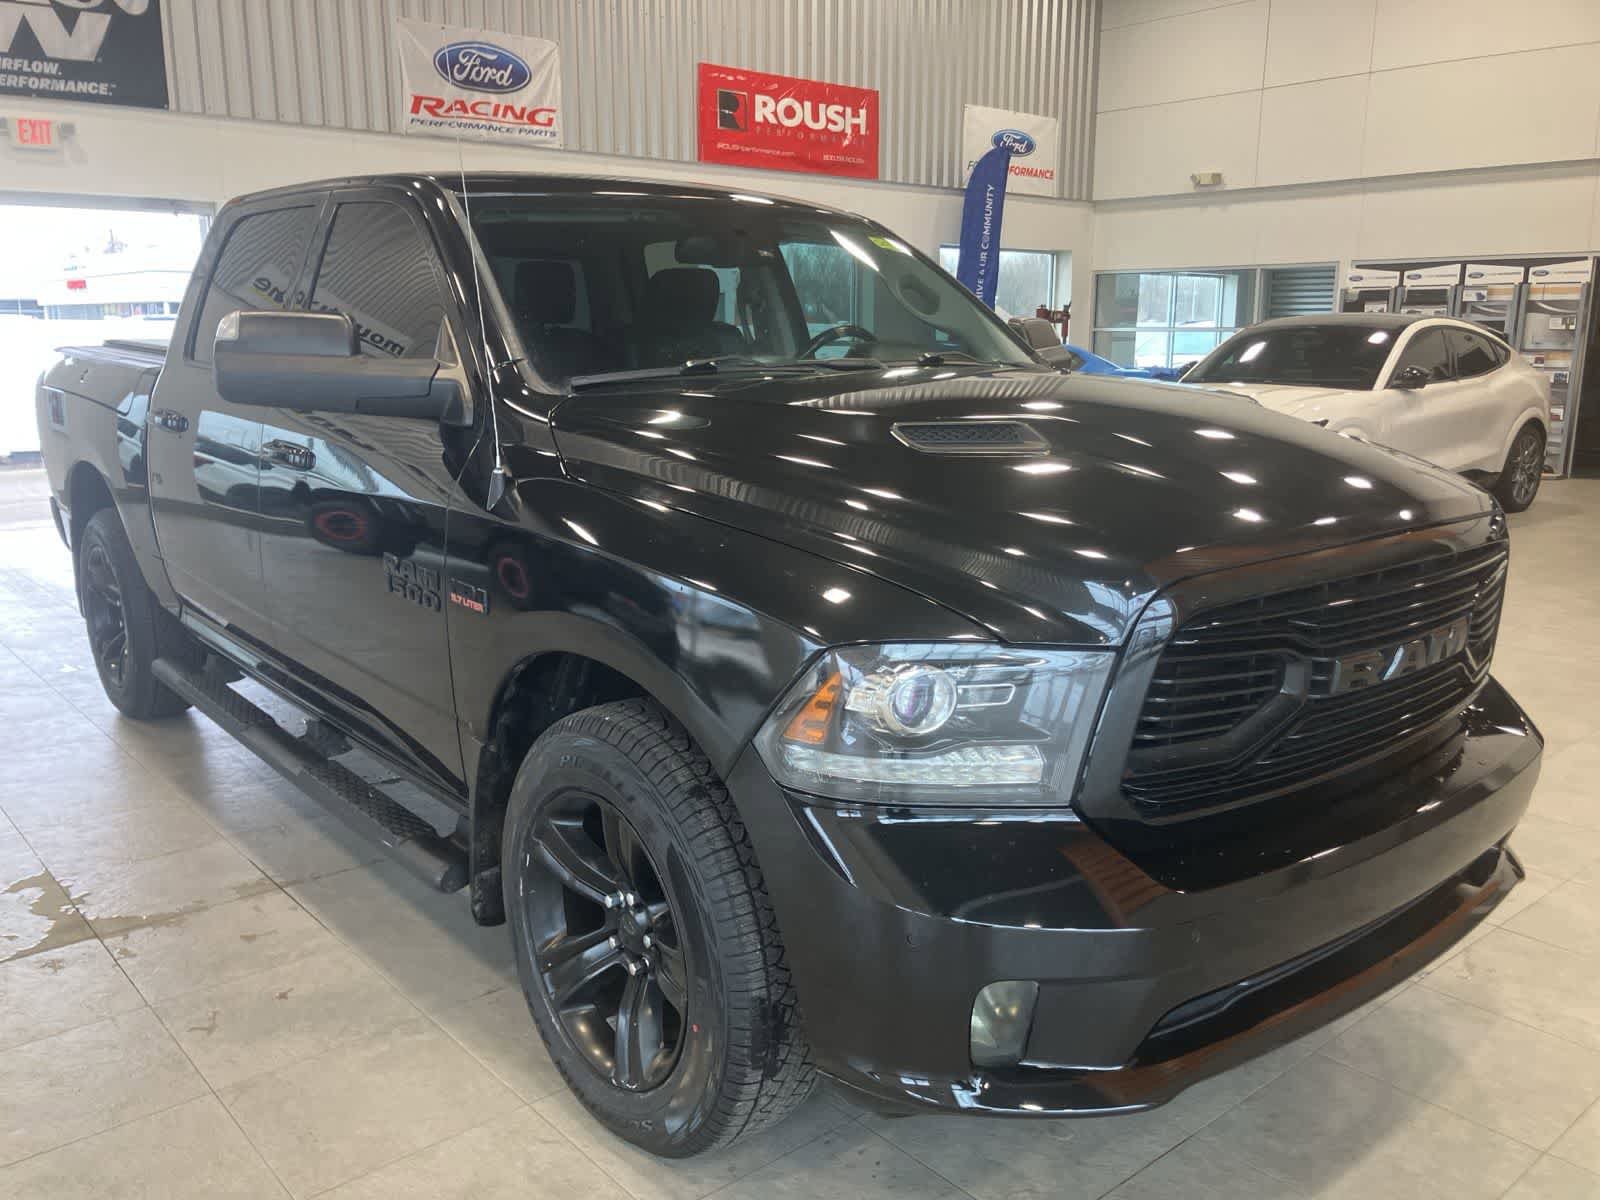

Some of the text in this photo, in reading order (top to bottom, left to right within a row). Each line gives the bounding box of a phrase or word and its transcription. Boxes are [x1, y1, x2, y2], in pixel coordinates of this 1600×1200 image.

[453, 48, 513, 87] Ford
[410, 94, 557, 127] RACING
[410, 117, 558, 138] PERFORMANCE PARTS
[755, 94, 867, 136] ROUSH
[16, 118, 52, 145] EXIT
[1008, 165, 1055, 181] FORMANCE
[383, 551, 441, 593] RAM
[1329, 613, 1472, 696] RAM
